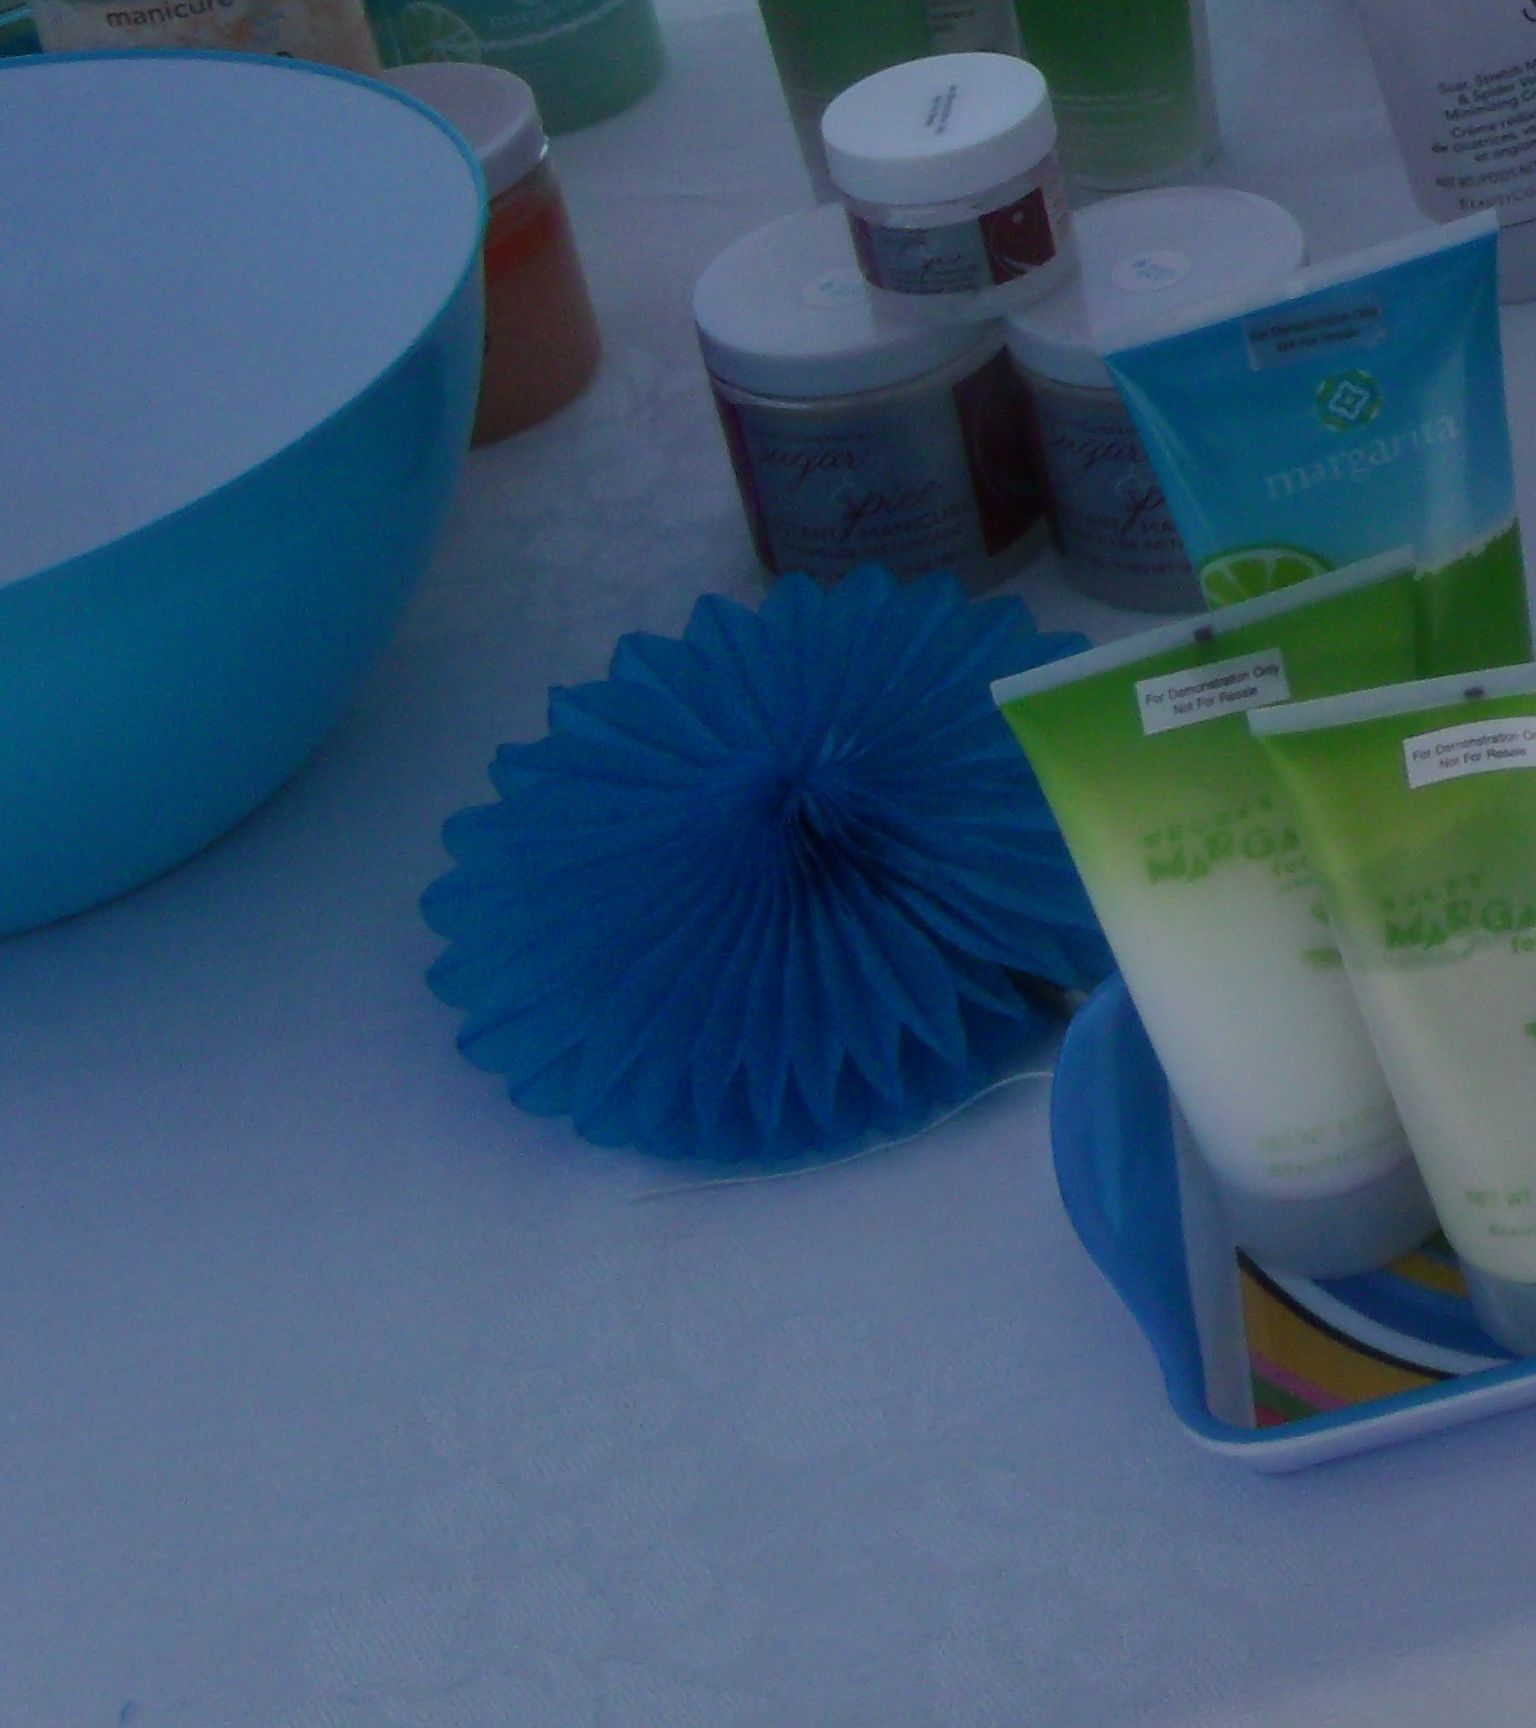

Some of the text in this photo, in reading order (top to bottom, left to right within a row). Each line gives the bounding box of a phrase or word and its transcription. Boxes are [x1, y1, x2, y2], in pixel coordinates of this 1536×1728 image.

[1264, 414, 1460, 502] margarita
[1145, 693, 1165, 704] For
[1412, 749, 1431, 761] For
[1435, 732, 1520, 755] Demonstration
[1463, 752, 1482, 764] For
[1147, 824, 1299, 886] MARGA
